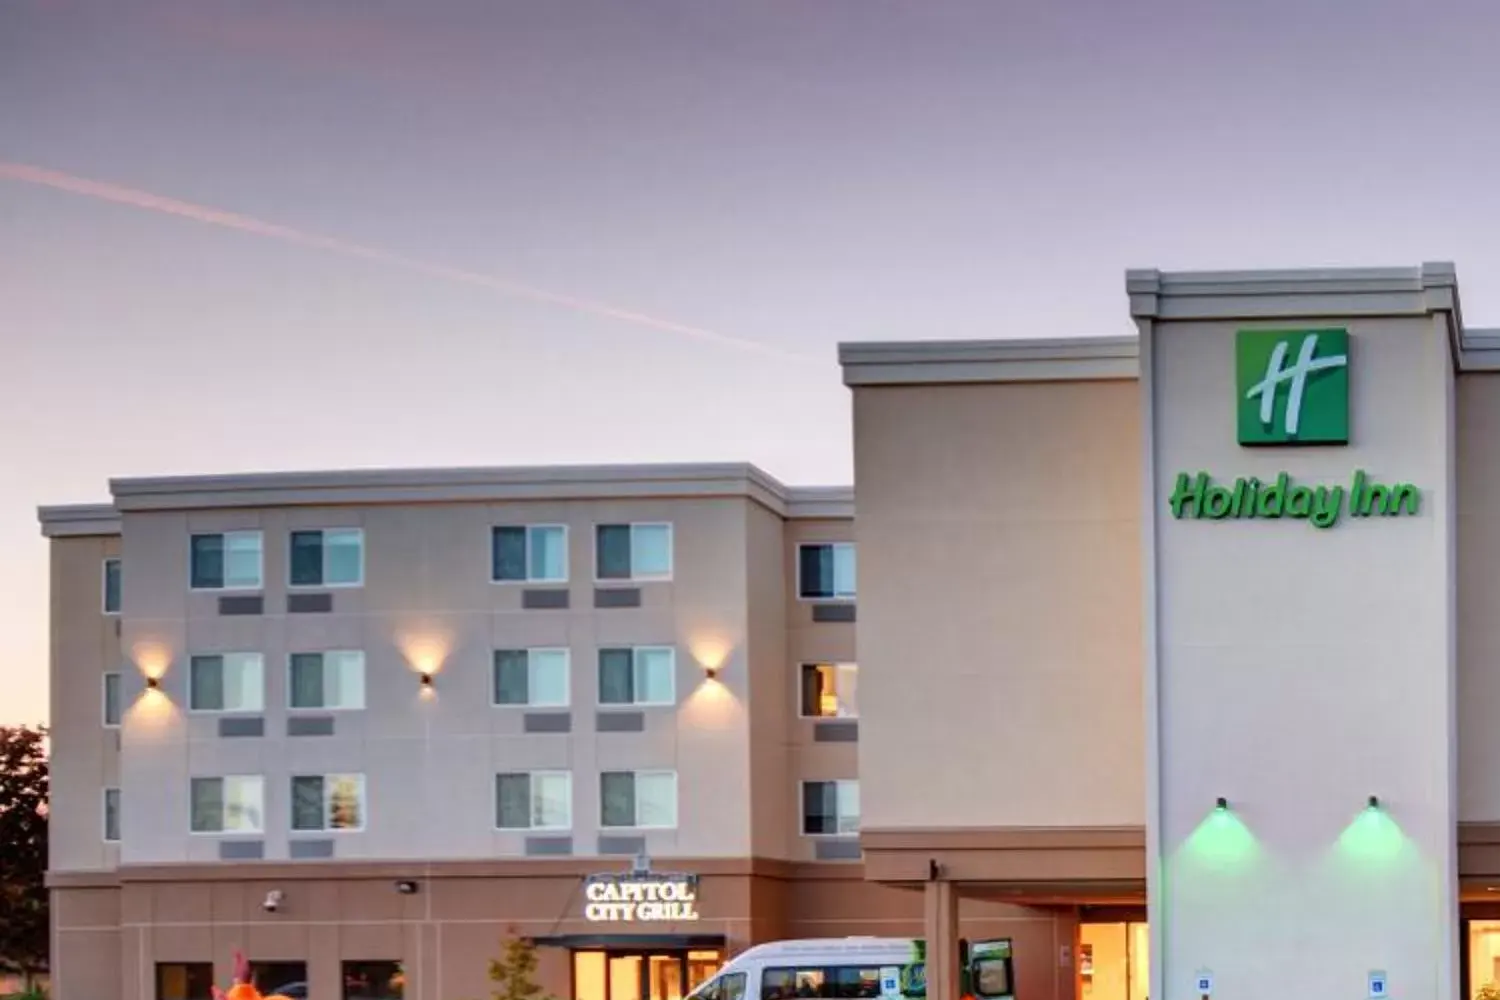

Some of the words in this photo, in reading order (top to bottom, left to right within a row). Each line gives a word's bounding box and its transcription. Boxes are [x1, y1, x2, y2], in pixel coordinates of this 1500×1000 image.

[1168, 471, 1344, 528] Holiday
[1350, 469, 1419, 517] Inn
[586, 881, 695, 901] CAPITOL
[585, 902, 636, 921] CITY
[636, 902, 699, 921] GRILL
